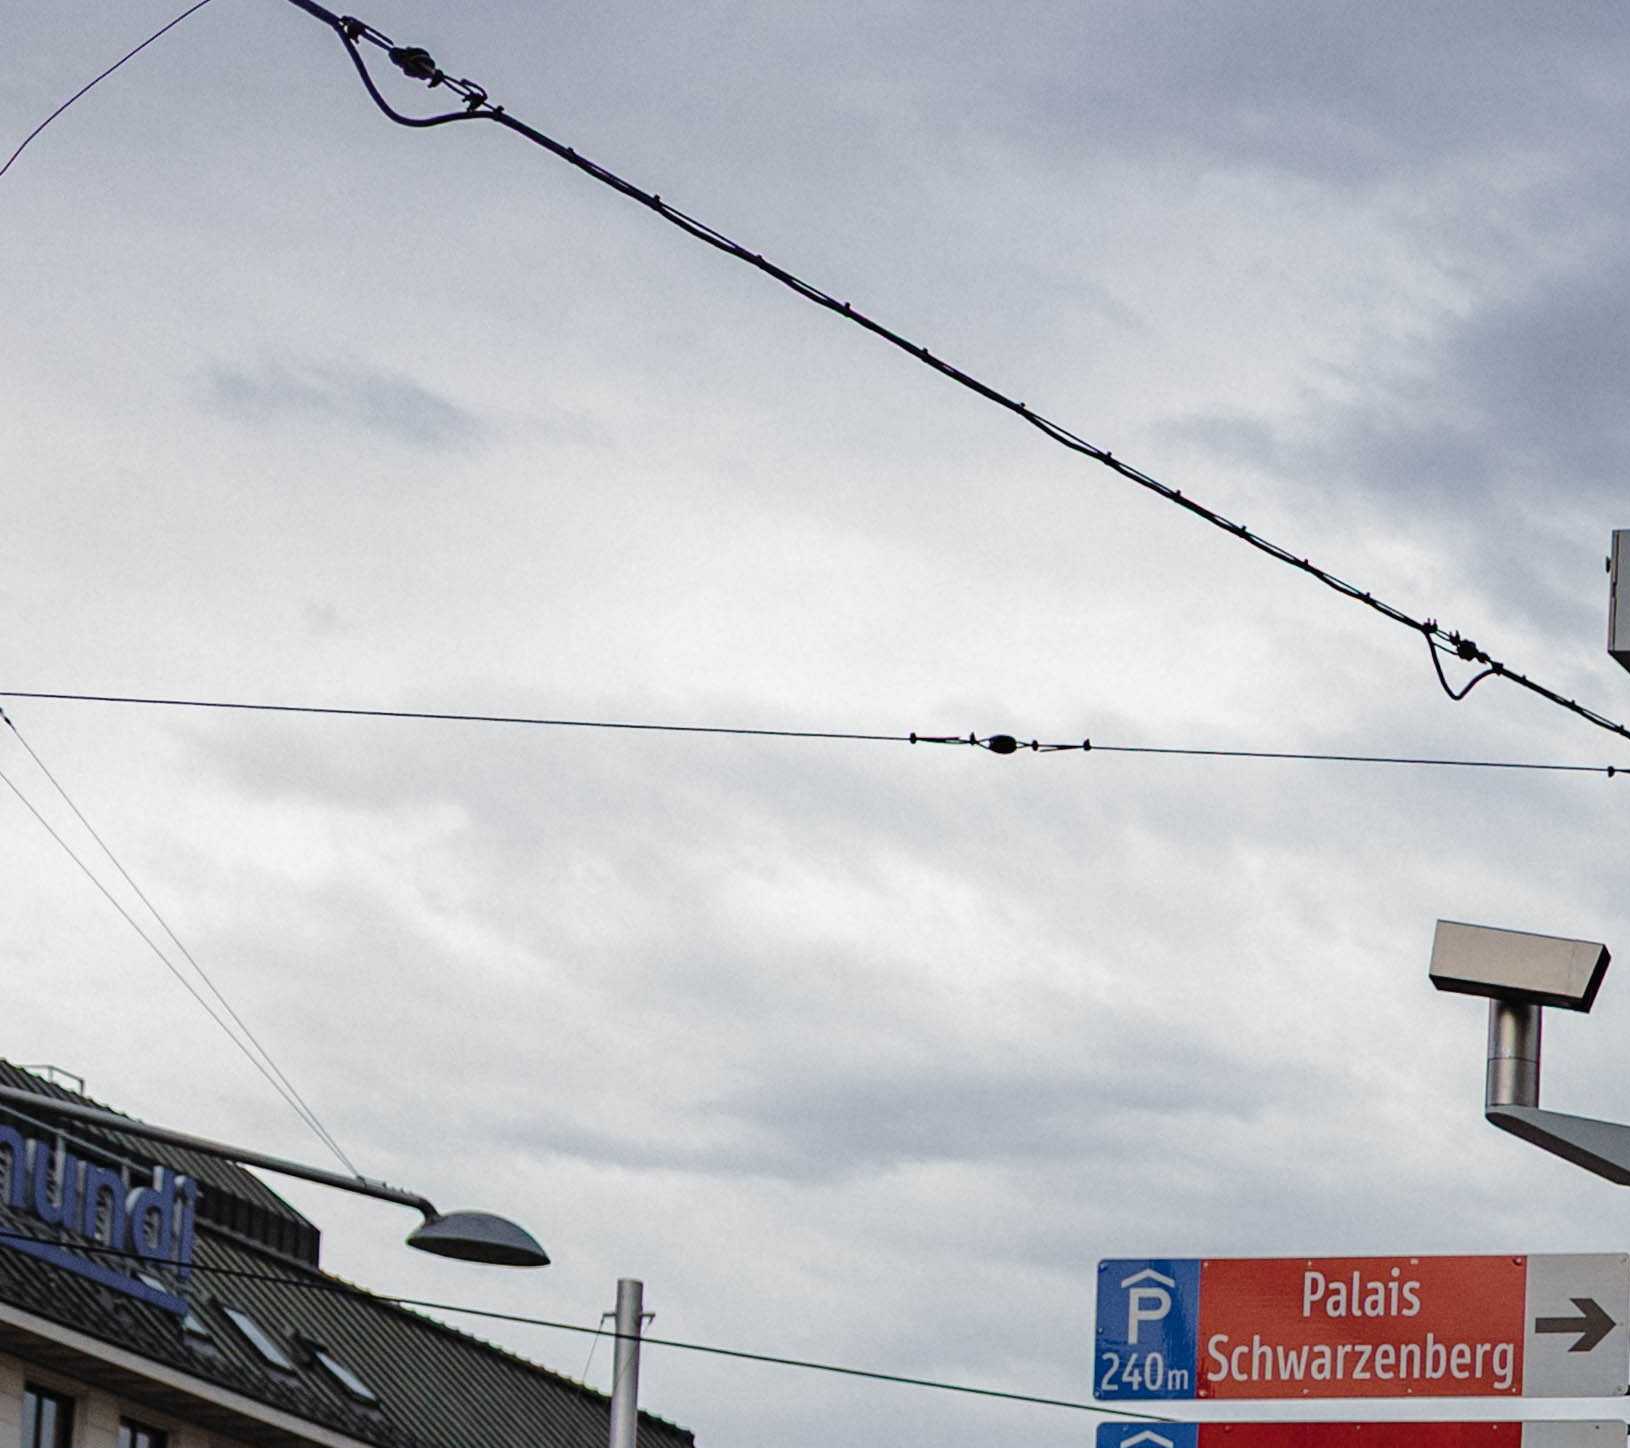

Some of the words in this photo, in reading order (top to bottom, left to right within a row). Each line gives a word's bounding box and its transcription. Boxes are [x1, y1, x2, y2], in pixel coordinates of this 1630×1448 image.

[1128, 1287, 1172, 1344] P
[1302, 1268, 1421, 1318] Palais
[1206, 1332, 1515, 1390] Schwarzenberg
